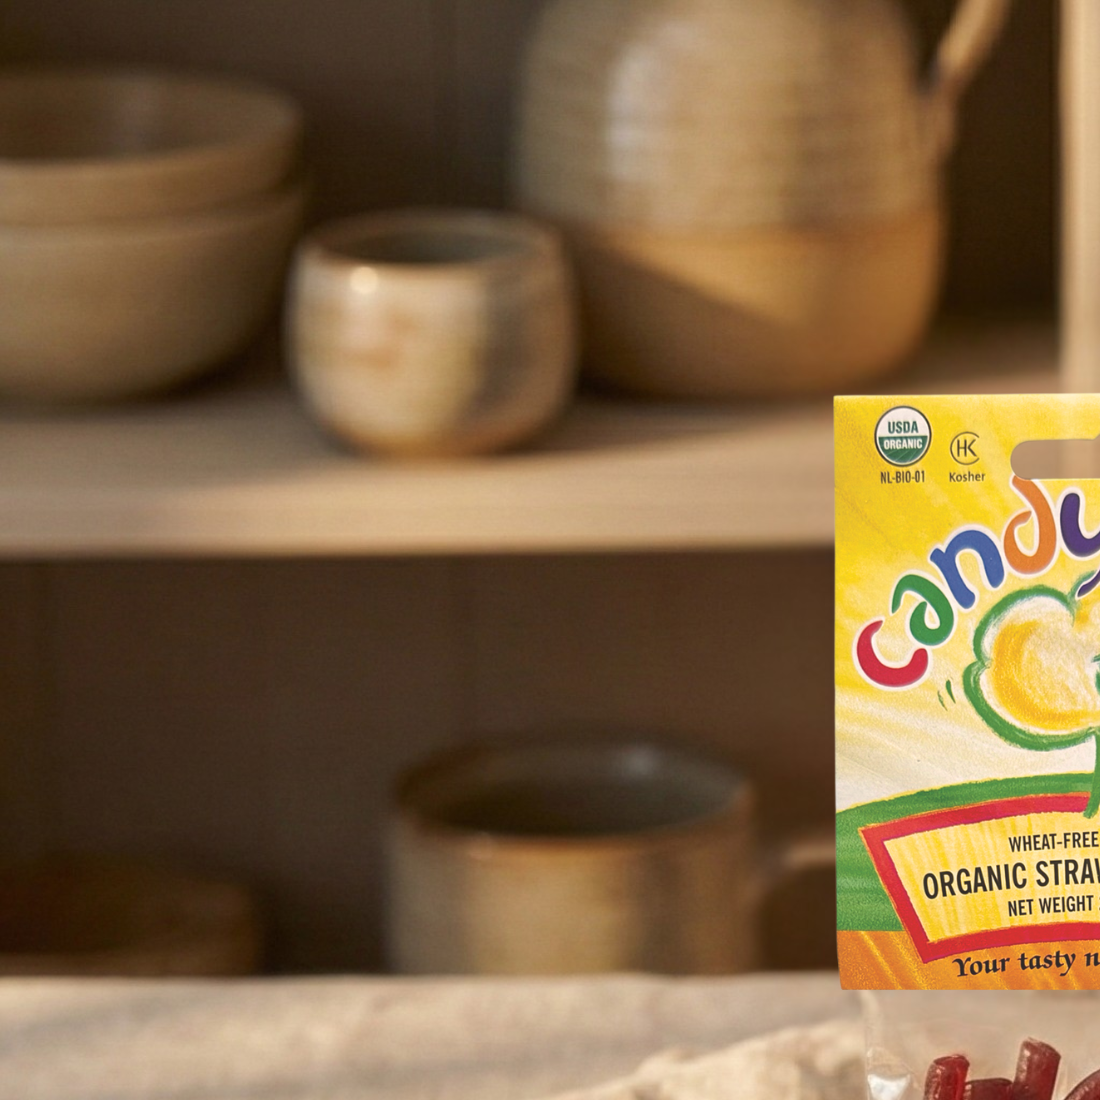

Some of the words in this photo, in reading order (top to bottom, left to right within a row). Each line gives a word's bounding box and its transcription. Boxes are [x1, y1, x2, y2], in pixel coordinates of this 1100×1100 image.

[888, 421, 919, 434] USDA
[884, 438, 922, 450] ORGANIC
[880, 470, 925, 484] NL-BIO-01
[949, 471, 986, 482] Kosher
[1009, 831, 1099, 852] WHEAT-FREE
[923, 862, 1027, 899] ORGANIC
[1008, 899, 1033, 916] NET
[1039, 895, 1094, 914] WEIGHT
[953, 957, 1010, 977] Your
[1017, 950, 1076, 976] tasty
